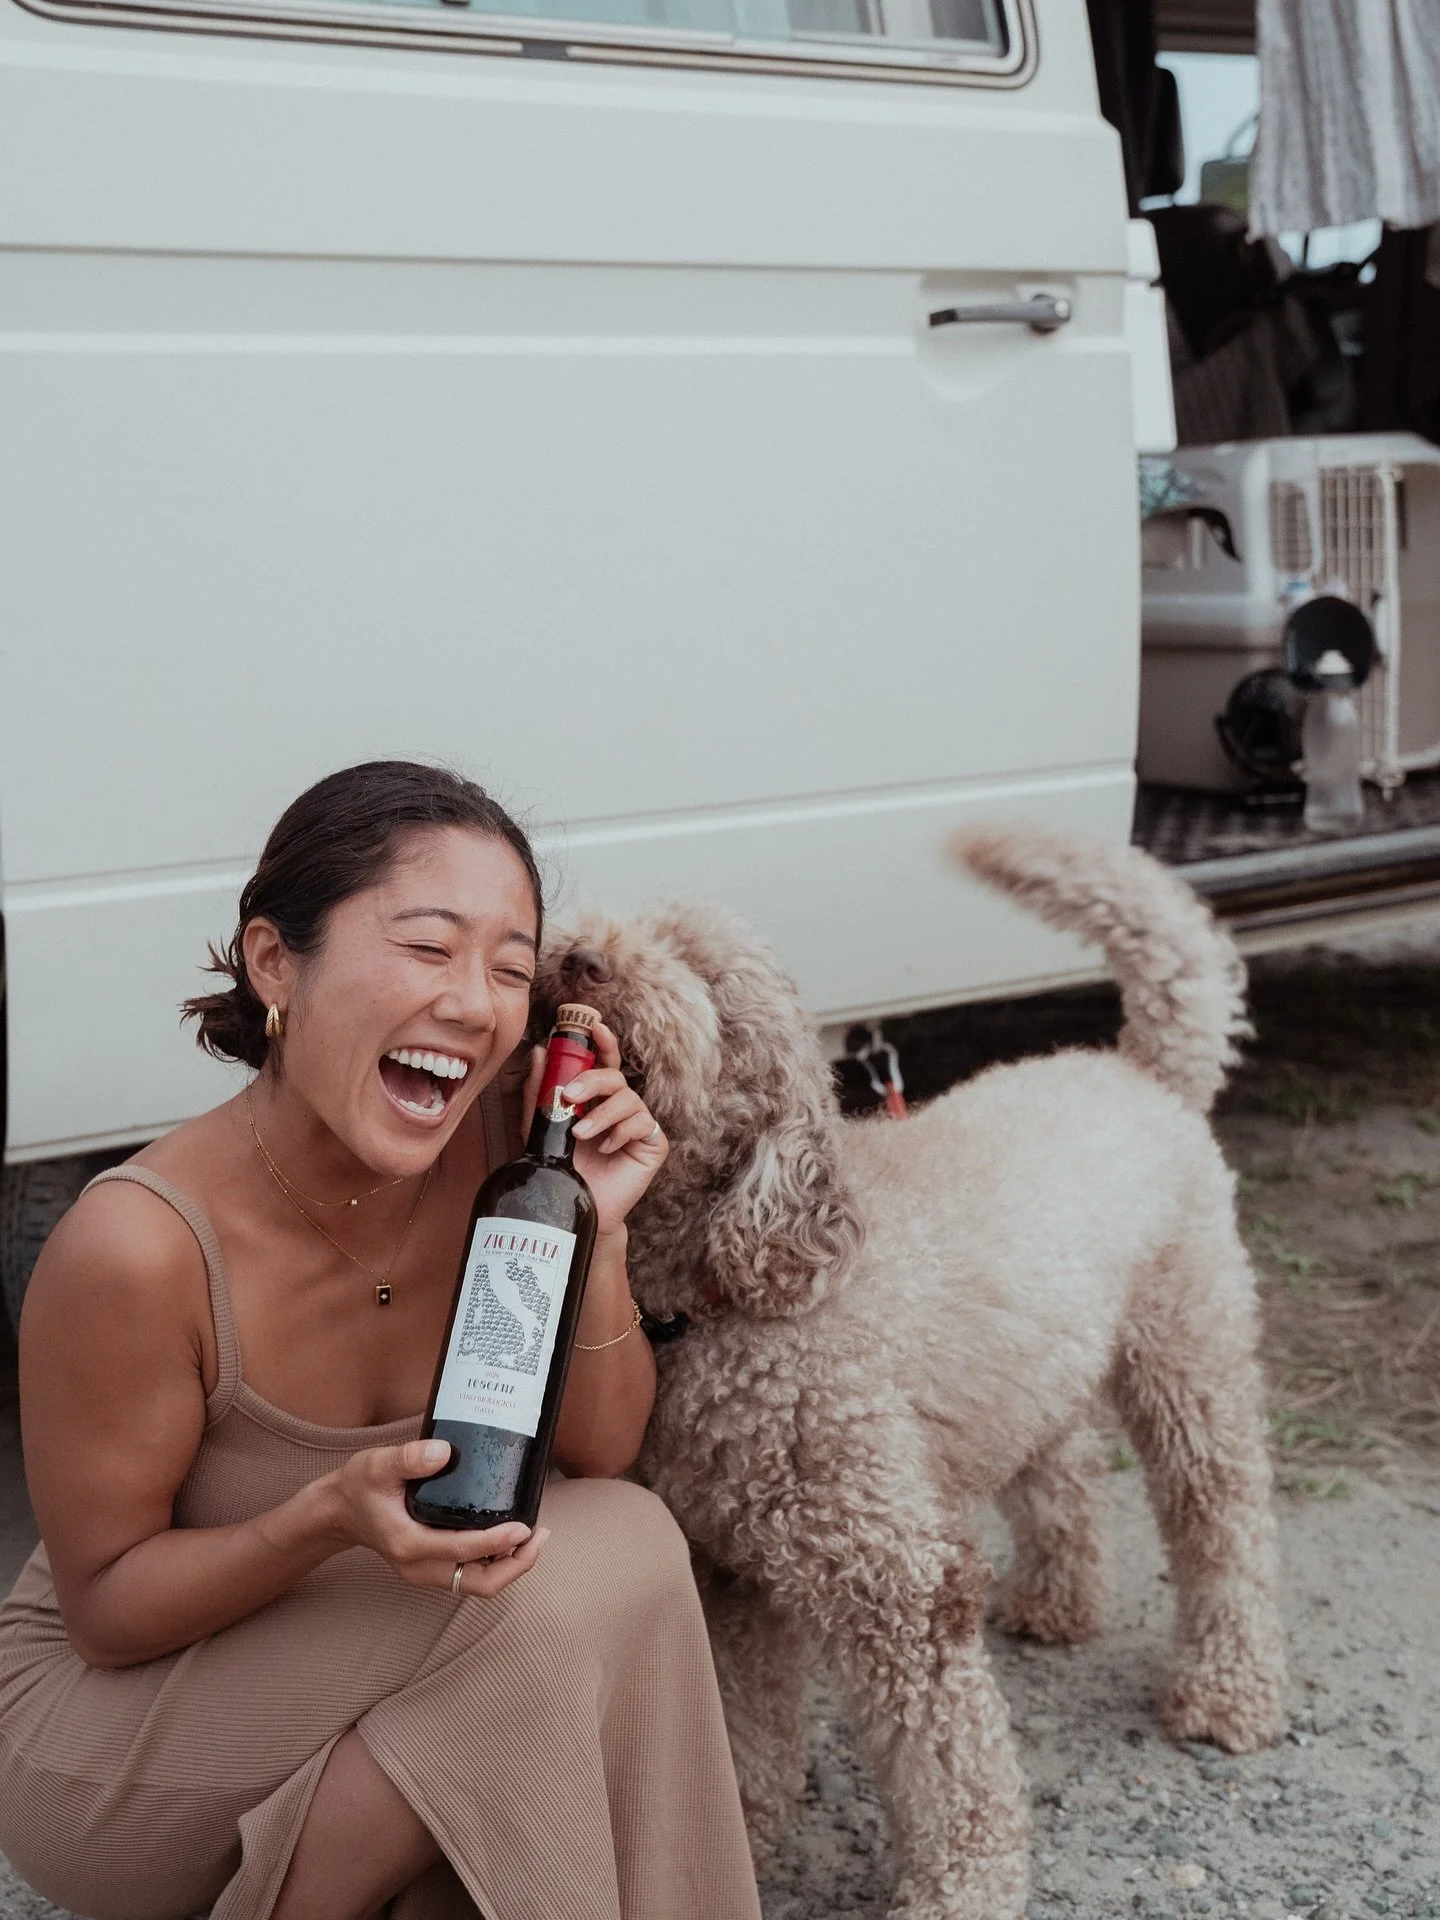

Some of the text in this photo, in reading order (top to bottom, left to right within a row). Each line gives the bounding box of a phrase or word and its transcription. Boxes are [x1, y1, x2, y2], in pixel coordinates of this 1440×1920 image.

[557, 1009, 595, 1027] BAFFA
[466, 1378, 515, 1394] TOSCANA
[459, 1393, 516, 1409] VINO BIOLOGICO
